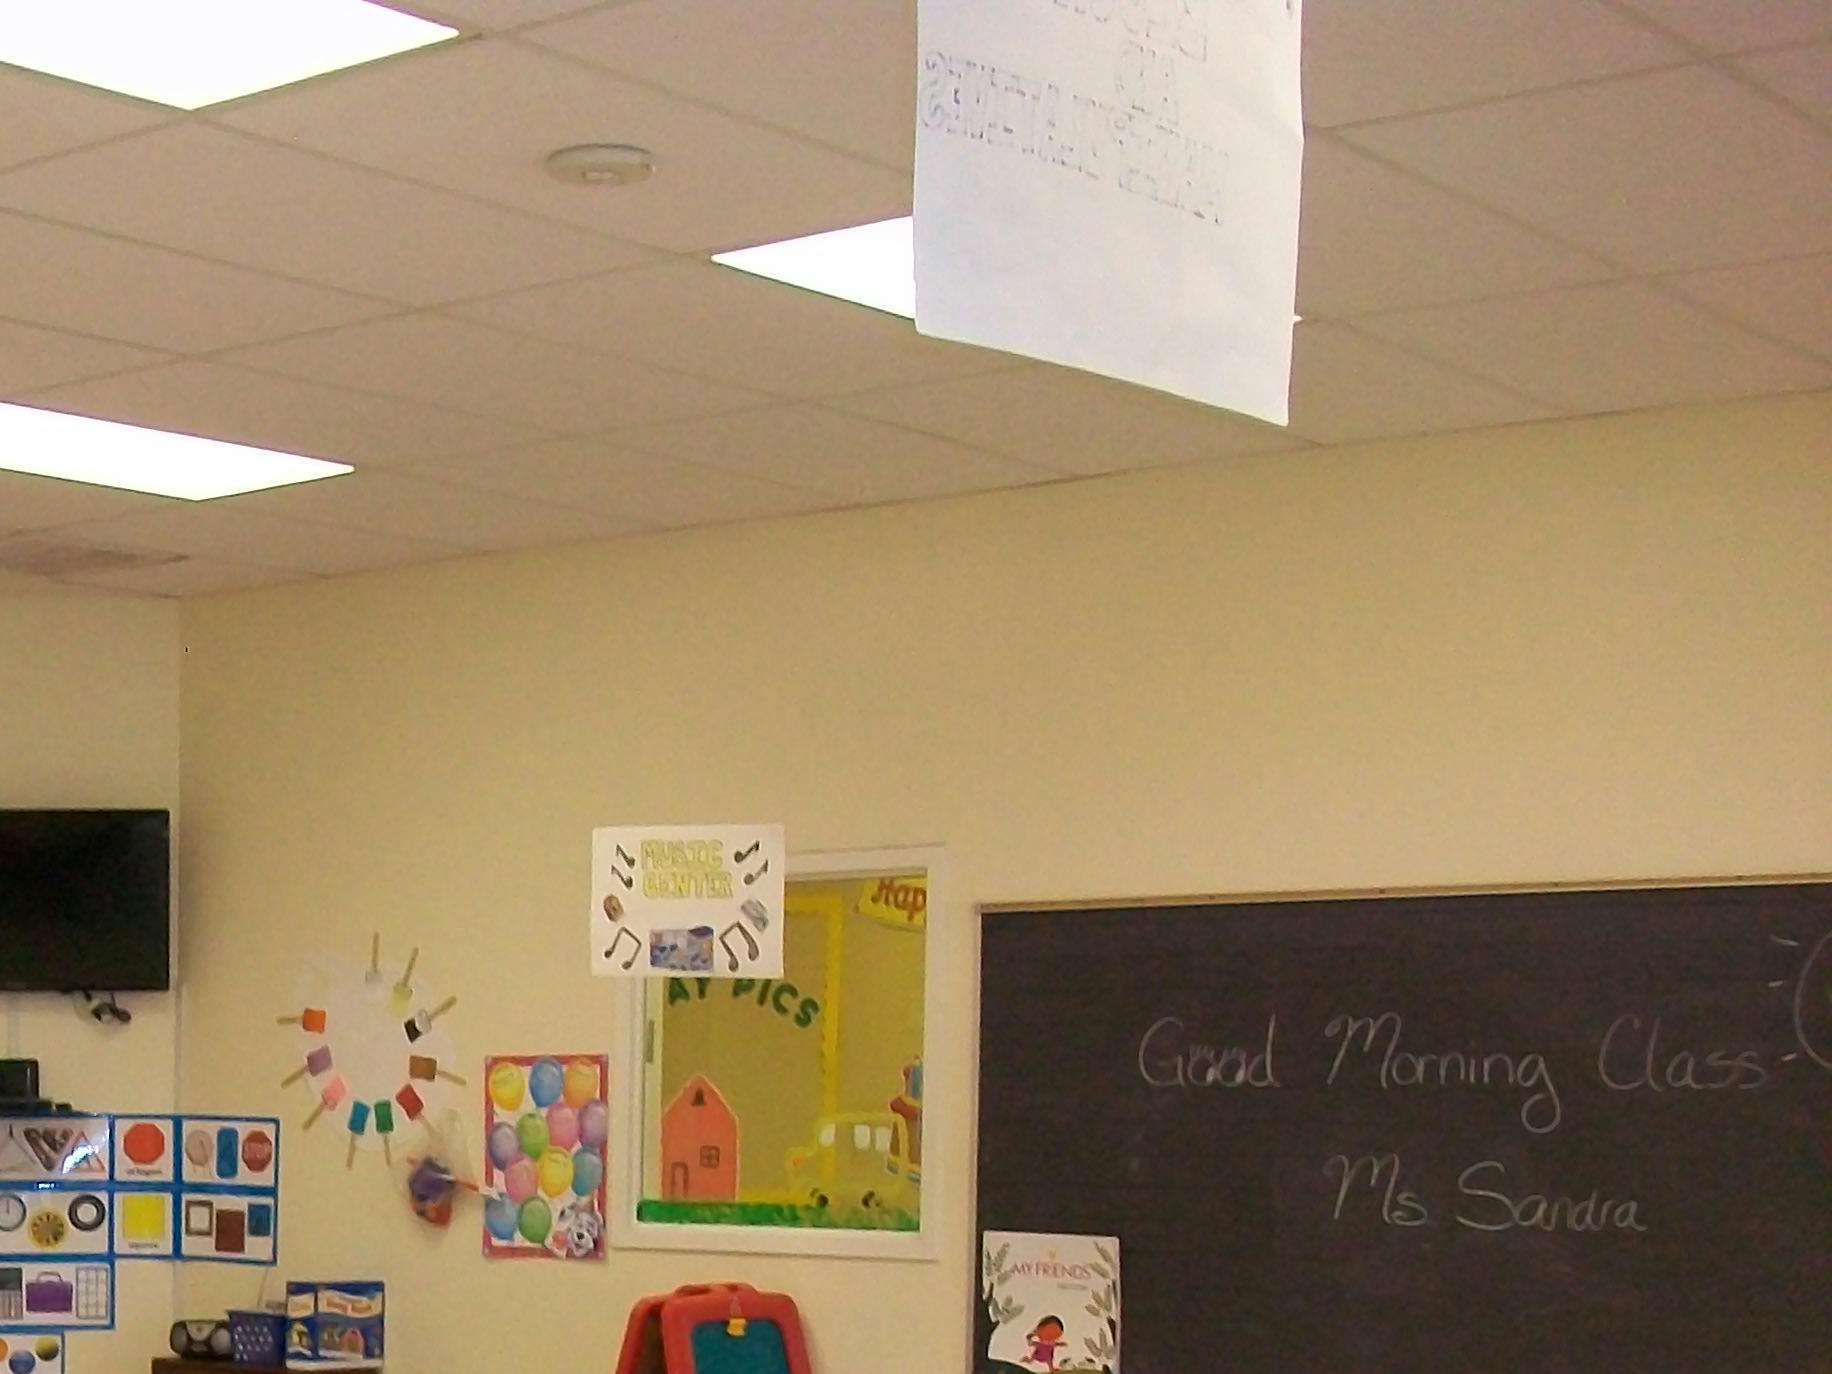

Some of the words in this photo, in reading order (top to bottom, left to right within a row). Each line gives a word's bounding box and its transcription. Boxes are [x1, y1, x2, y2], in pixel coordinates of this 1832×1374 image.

[640, 839, 724, 870] MUSIC
[643, 871, 733, 898] CENTER
[1138, 1013, 1281, 1089] Good
[1324, 1011, 1561, 1133] Morning
[1599, 1014, 1768, 1092] Class
[1323, 1153, 1428, 1225] Ms
[1456, 1160, 1646, 1232] Sandra
